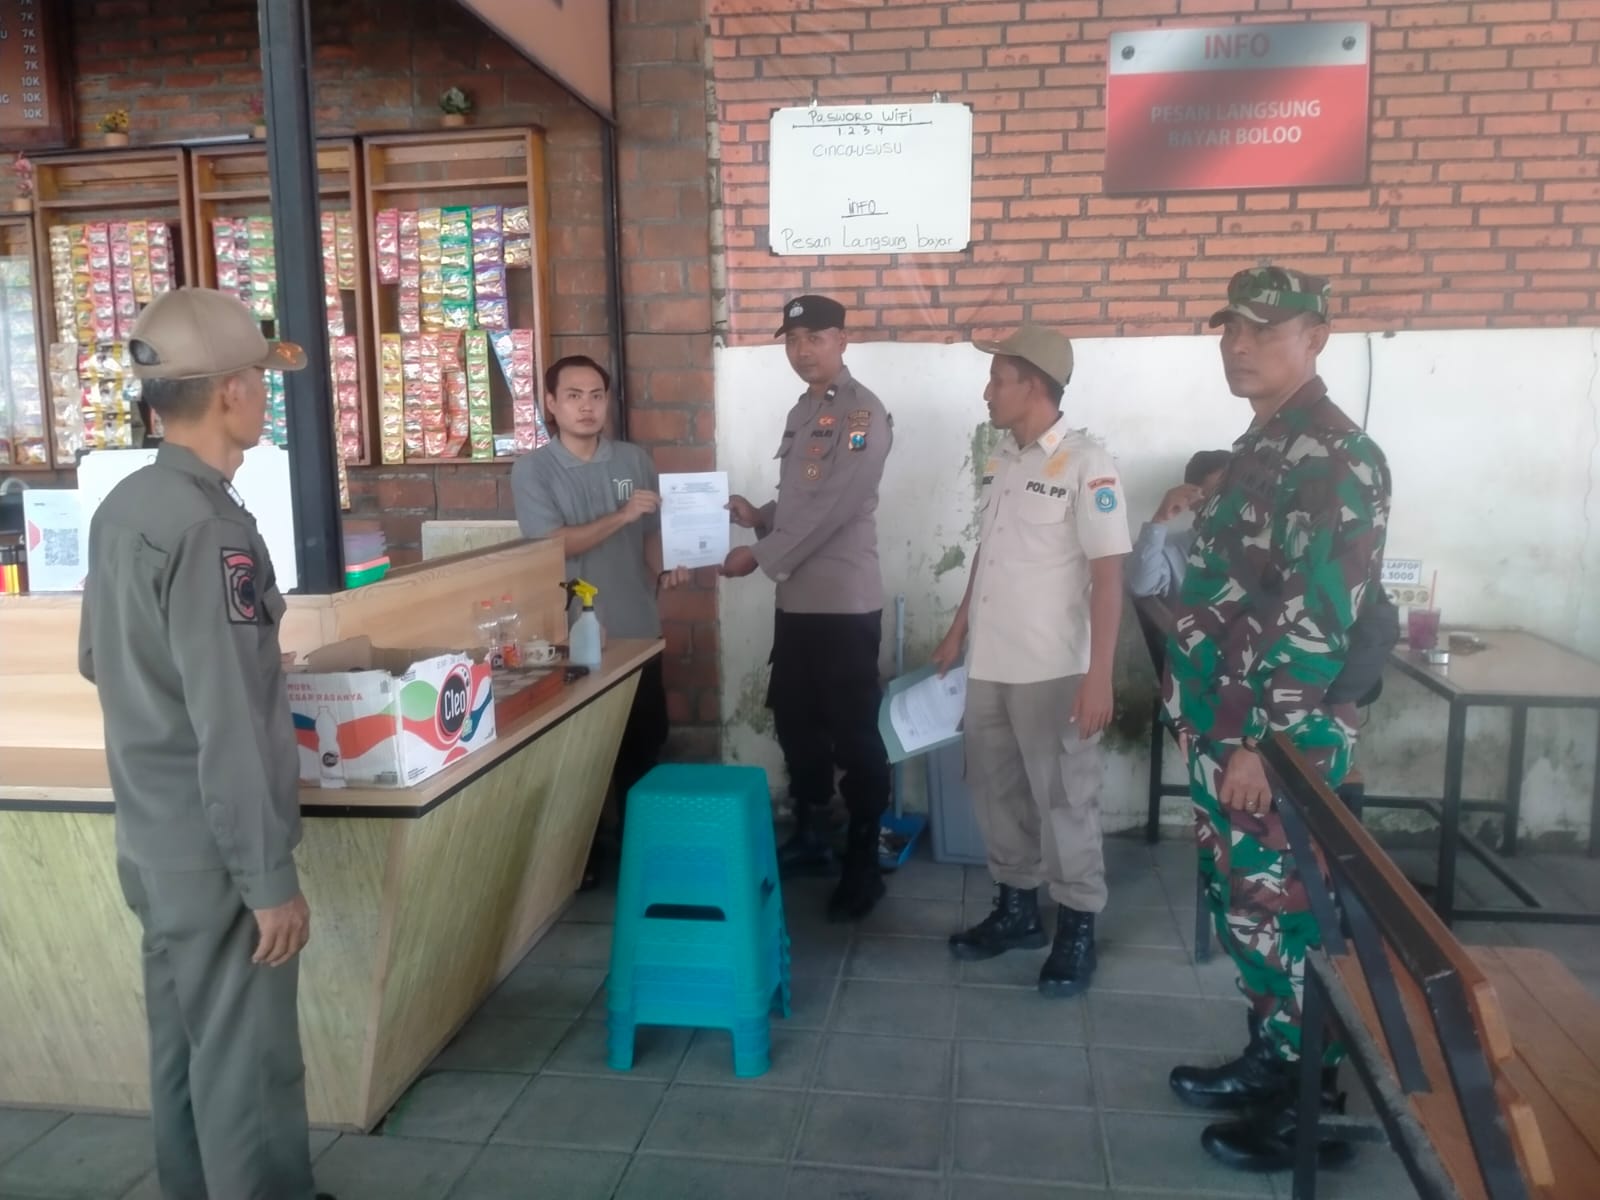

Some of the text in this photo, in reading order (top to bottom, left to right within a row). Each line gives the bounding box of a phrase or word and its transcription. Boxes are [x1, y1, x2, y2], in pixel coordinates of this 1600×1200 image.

[21, 12, 34, 21] 7K
[21, 28, 36, 38] 7K
[23, 44, 37, 54] 7K
[1204, 32, 1271, 60] INFO
[24, 61, 39, 70] 7K
[21, 77, 40, 87] 10K
[22, 92, 41, 103] 10K
[23, 107, 42, 118] 10K
[1151, 98, 1321, 123] PESAN LANGSUNG
[1168, 125, 1302, 148] BAYAR BOLOO
[781, 227, 832, 251] Pesan
[1025, 480, 1067, 499] POL PP
[444, 688, 466, 721] Cleo
